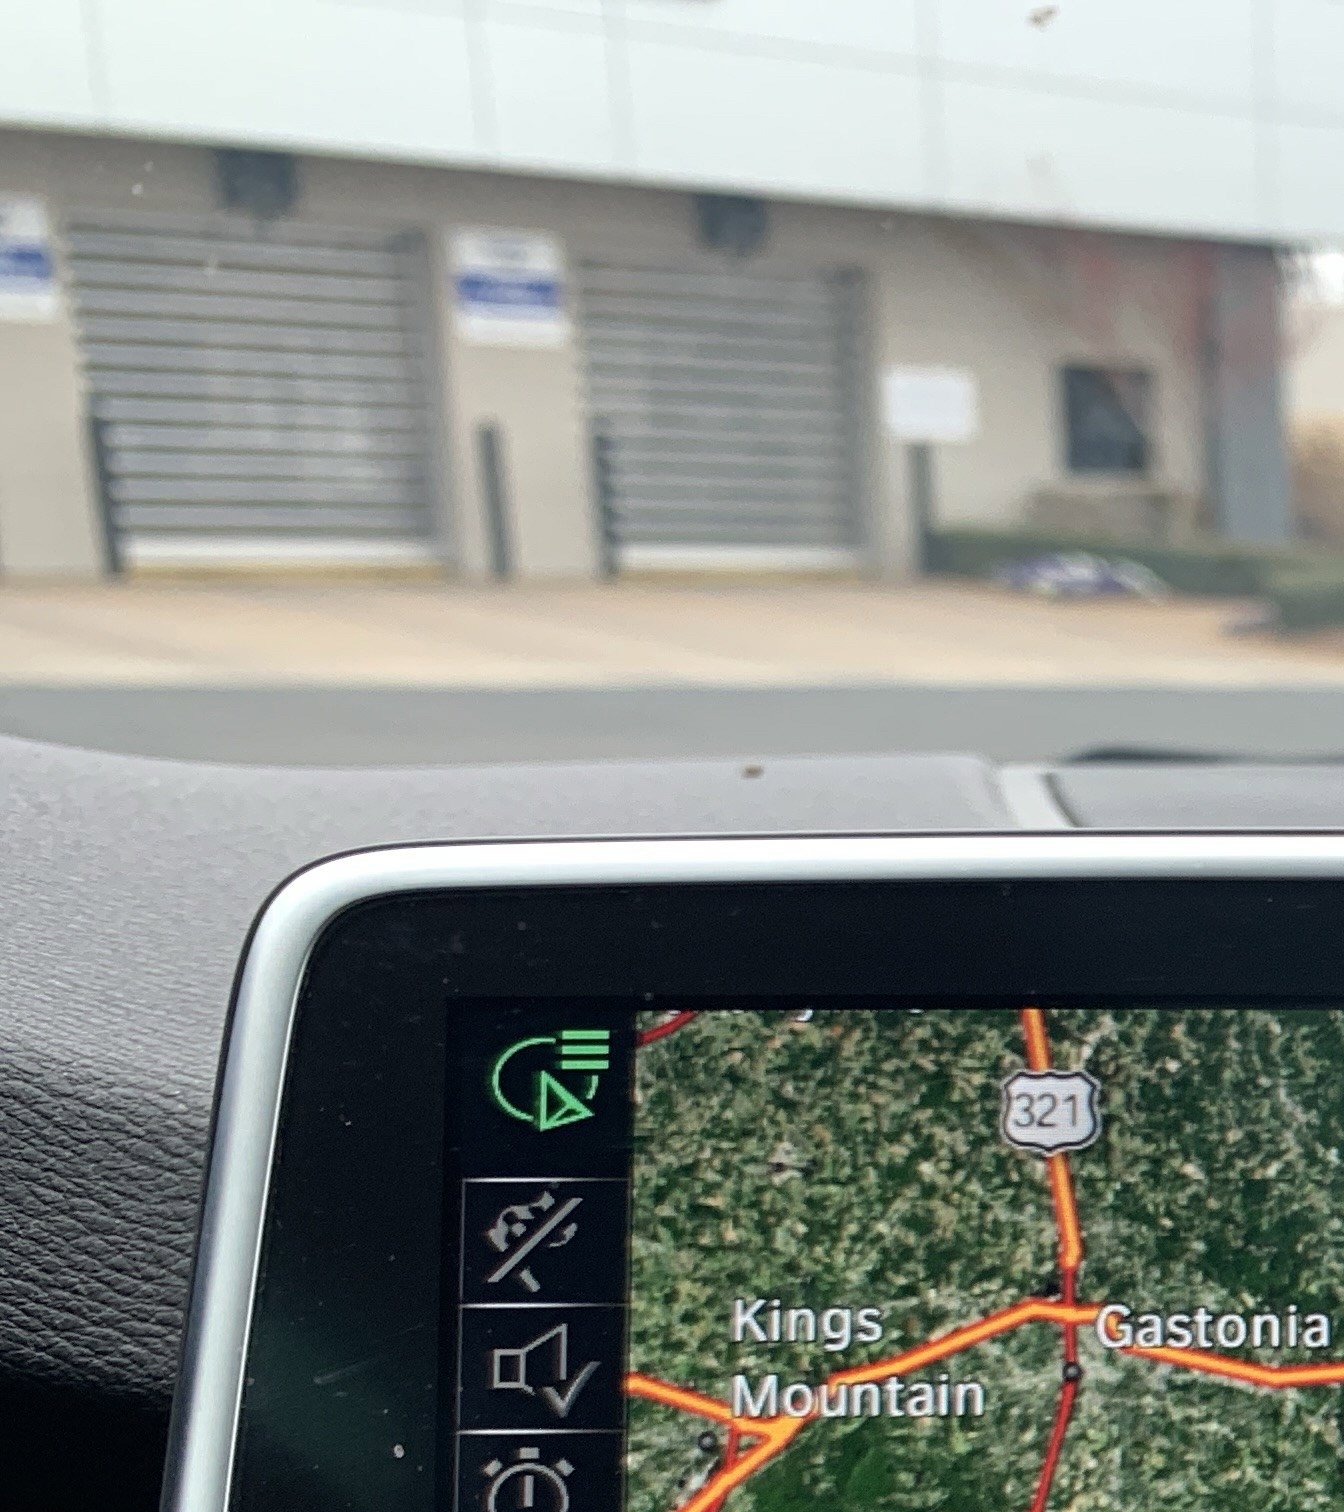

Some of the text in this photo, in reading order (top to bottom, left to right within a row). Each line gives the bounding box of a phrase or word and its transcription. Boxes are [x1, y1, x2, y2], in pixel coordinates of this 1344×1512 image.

[1012, 1094, 1081, 1130] 321
[732, 1299, 884, 1349] Kings
[1097, 1304, 1331, 1349] Gastonia
[732, 1374, 986, 1416] Mountain
